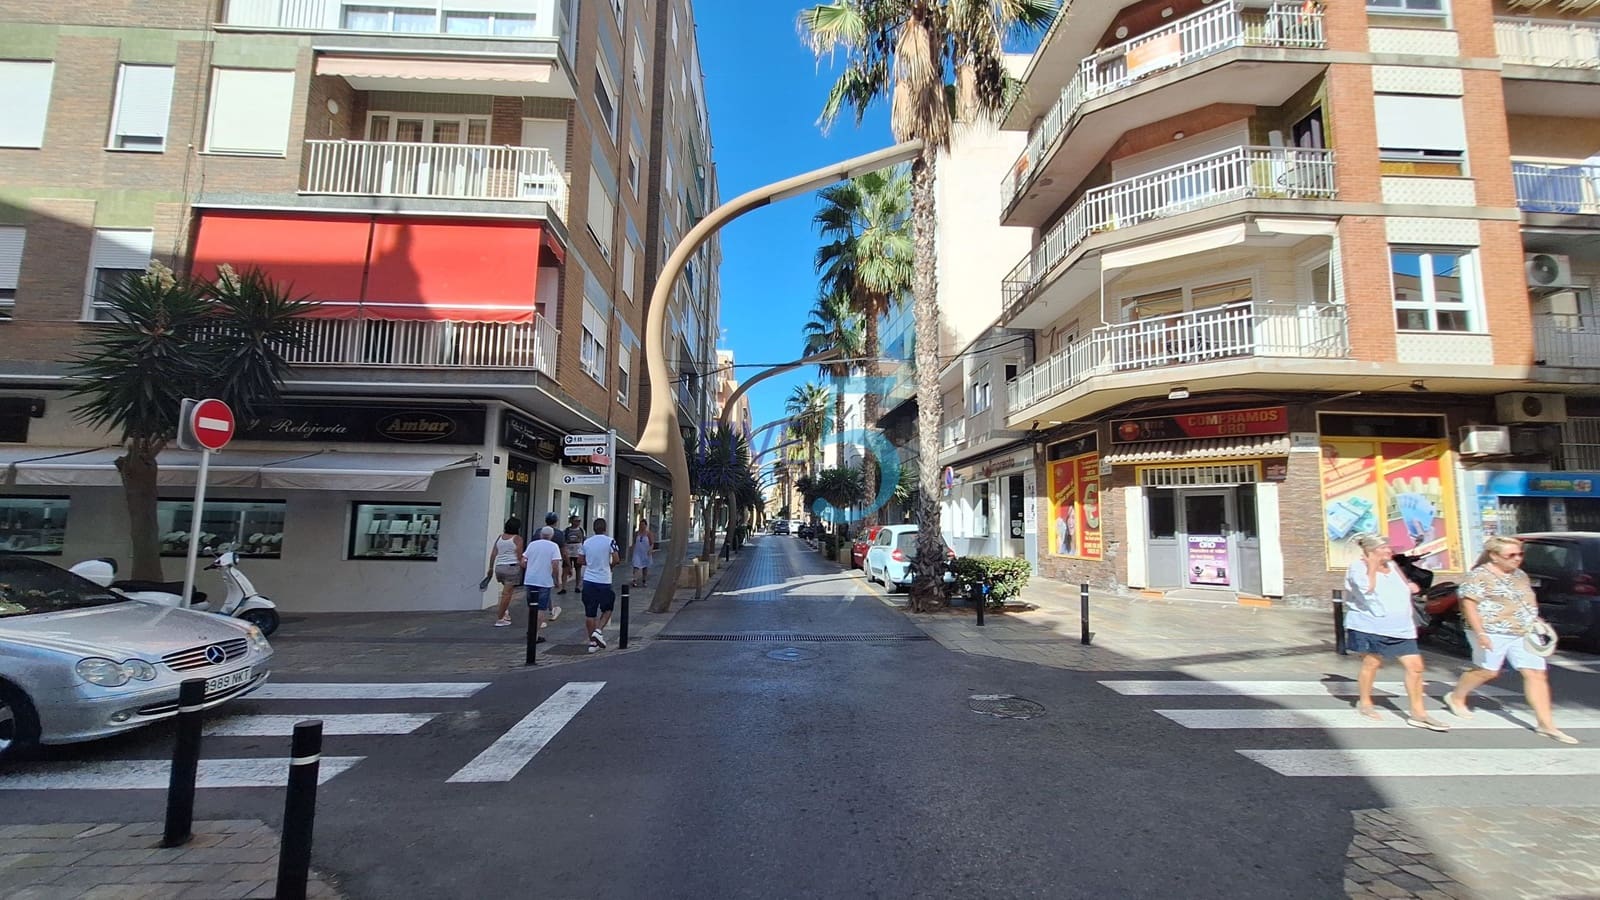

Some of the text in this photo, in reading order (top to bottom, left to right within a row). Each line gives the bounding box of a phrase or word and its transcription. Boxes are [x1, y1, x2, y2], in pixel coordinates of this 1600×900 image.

[386, 418, 449, 432] Ambar
[1188, 410, 1279, 426] COMPRAMOS
[1218, 423, 1246, 434] ORO
[516, 471, 529, 483] ORO
[231, 669, 250, 685] NKT
